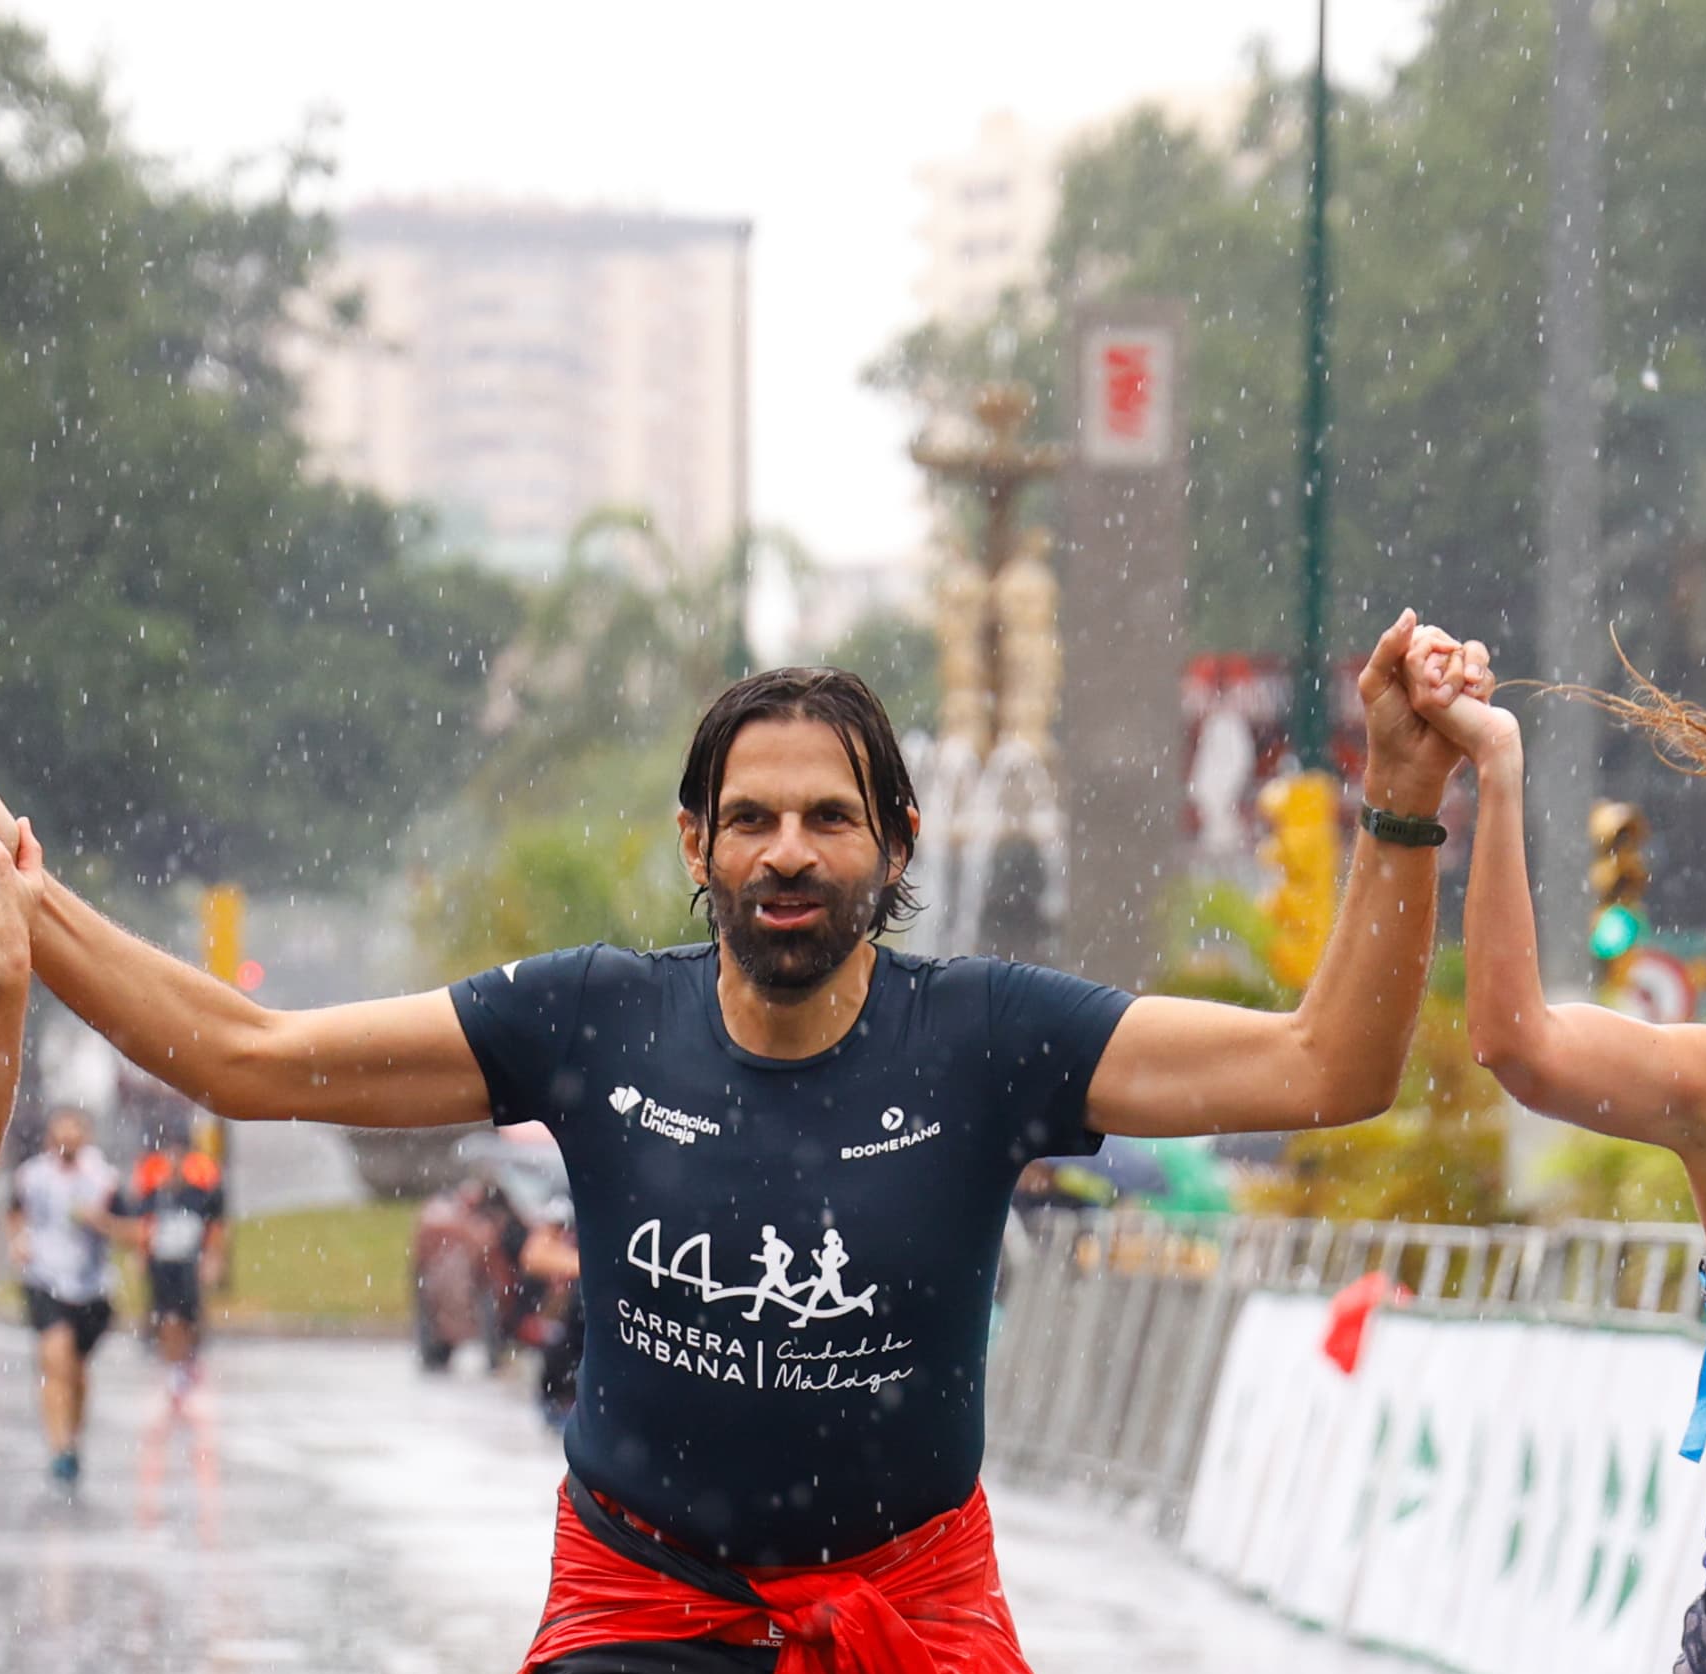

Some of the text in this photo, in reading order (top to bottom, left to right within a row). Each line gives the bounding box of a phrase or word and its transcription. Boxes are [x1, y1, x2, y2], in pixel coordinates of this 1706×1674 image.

[640, 1111, 696, 1145] Unicaja
[643, 1097, 721, 1136] Fundación
[841, 1121, 941, 1159] BOOMERANG
[627, 1219, 723, 1303] 44
[618, 1299, 745, 1358] CARRERA
[776, 1333, 912, 1360] Ciudad de
[620, 1322, 745, 1385] URBANA
[774, 1363, 913, 1394] Málaga
